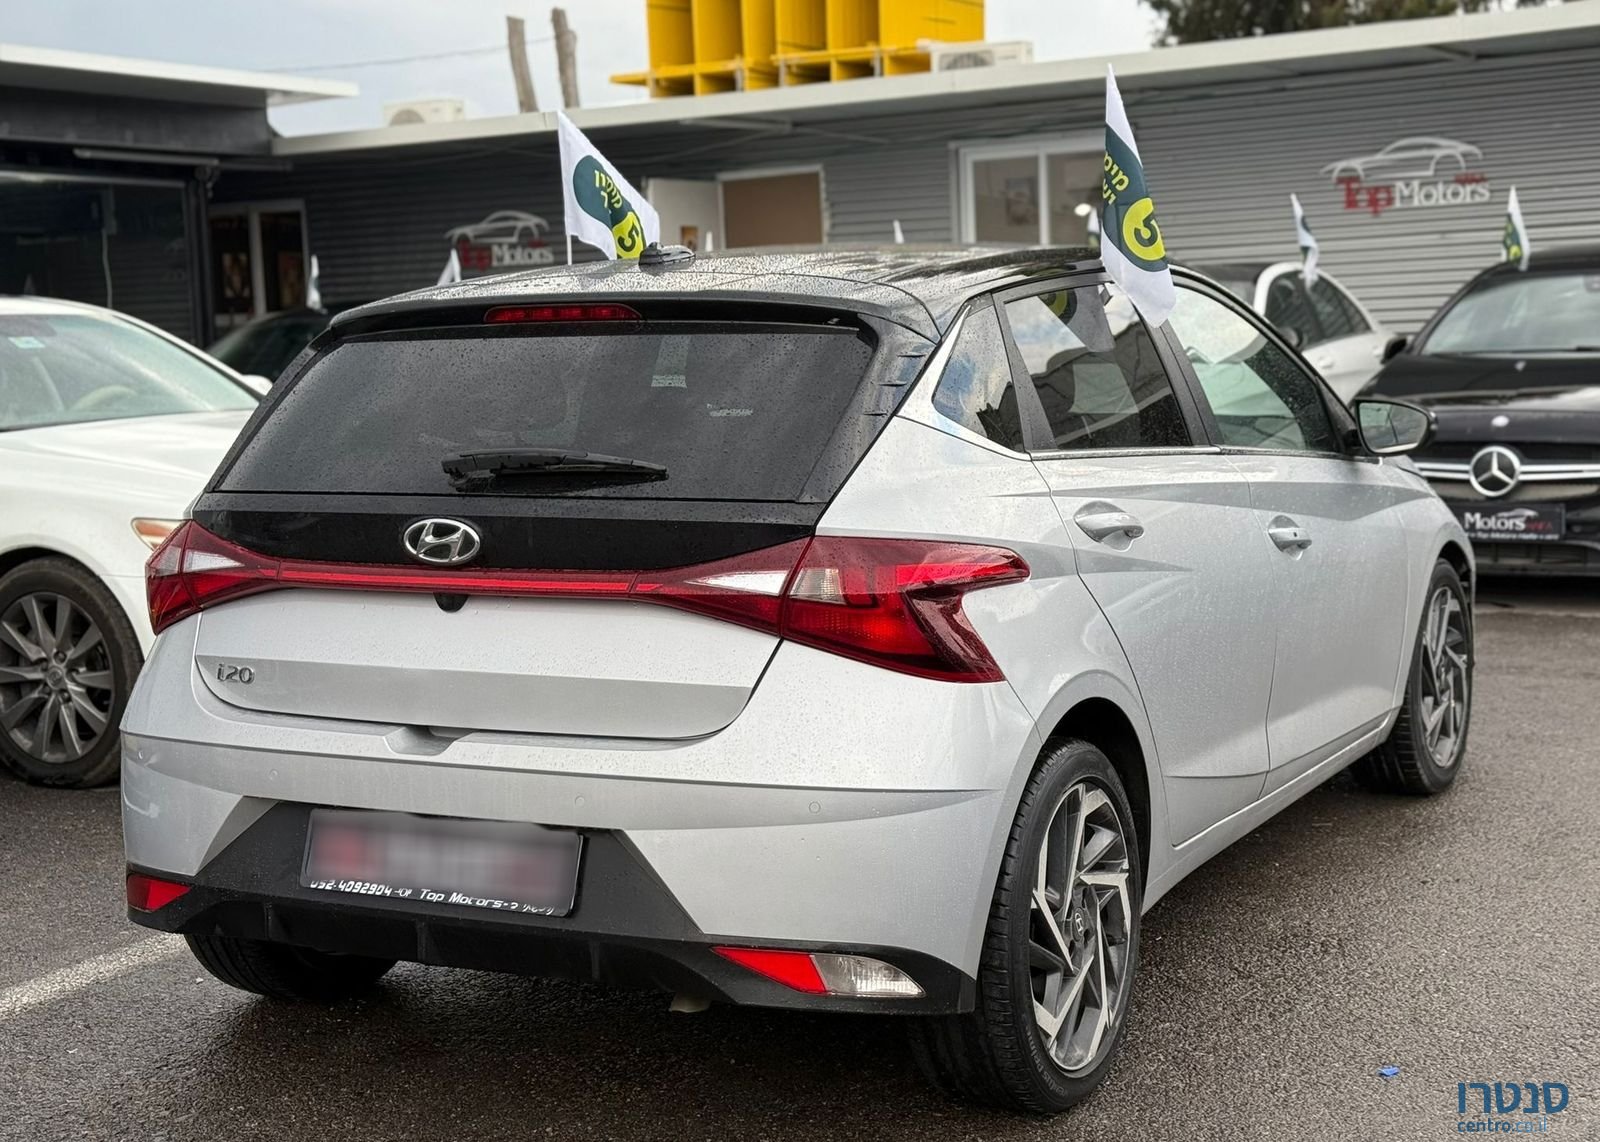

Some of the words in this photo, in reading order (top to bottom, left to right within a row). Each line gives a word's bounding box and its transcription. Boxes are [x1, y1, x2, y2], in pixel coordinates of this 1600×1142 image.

[616, 222, 641, 253] 5
[1463, 511, 1526, 531] Motors
[216, 662, 255, 685] i20
[420, 888, 446, 903] Top
